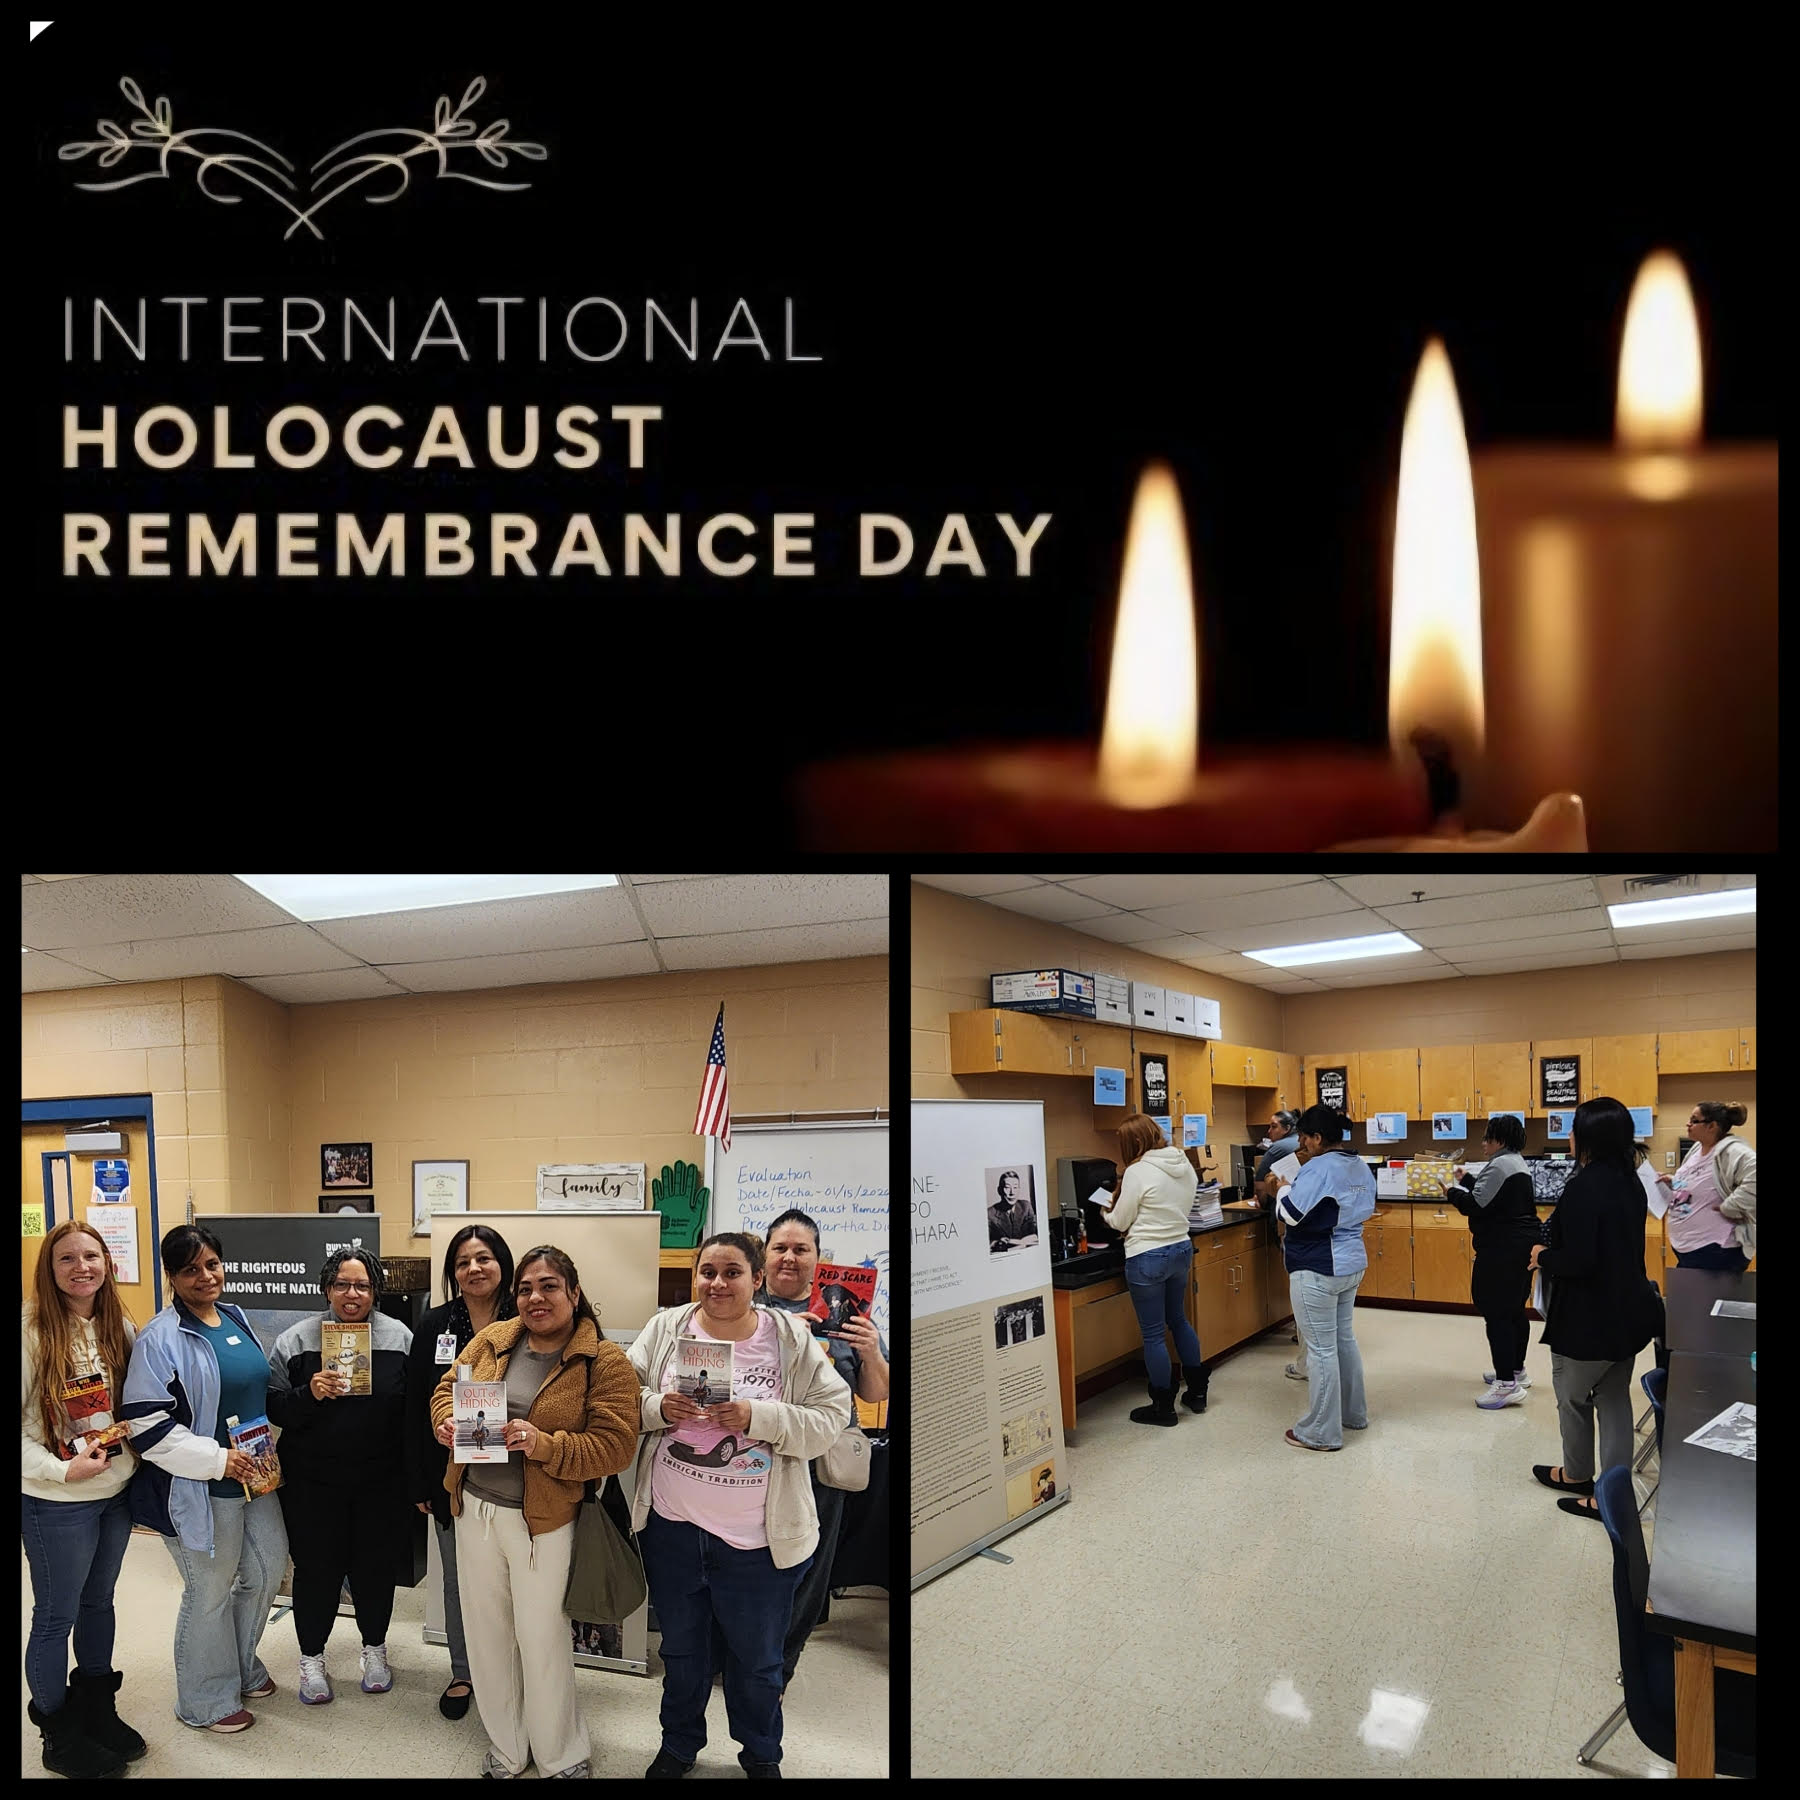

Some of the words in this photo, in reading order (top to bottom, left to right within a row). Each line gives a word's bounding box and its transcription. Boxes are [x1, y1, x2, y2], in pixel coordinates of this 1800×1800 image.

[738, 1165, 812, 1184] Evaluation
[560, 1177, 623, 1198] family
[739, 1203, 775, 1214] Class
[742, 1216, 771, 1232] Pres
[241, 1262, 306, 1275] RIGHTEOUS
[818, 1268, 839, 1280] RED
[841, 1270, 873, 1284] SCARE
[265, 1282, 286, 1294] THE
[687, 1346, 712, 1358] OUT
[682, 1356, 725, 1369] HIDING
[742, 1374, 776, 1389] 1970
[463, 1388, 488, 1399] OUT
[488, 1390, 497, 1398] of
[460, 1398, 500, 1409] HIDING
[662, 1456, 704, 1479] AMERICAN
[708, 1475, 763, 1485] TRADITION
